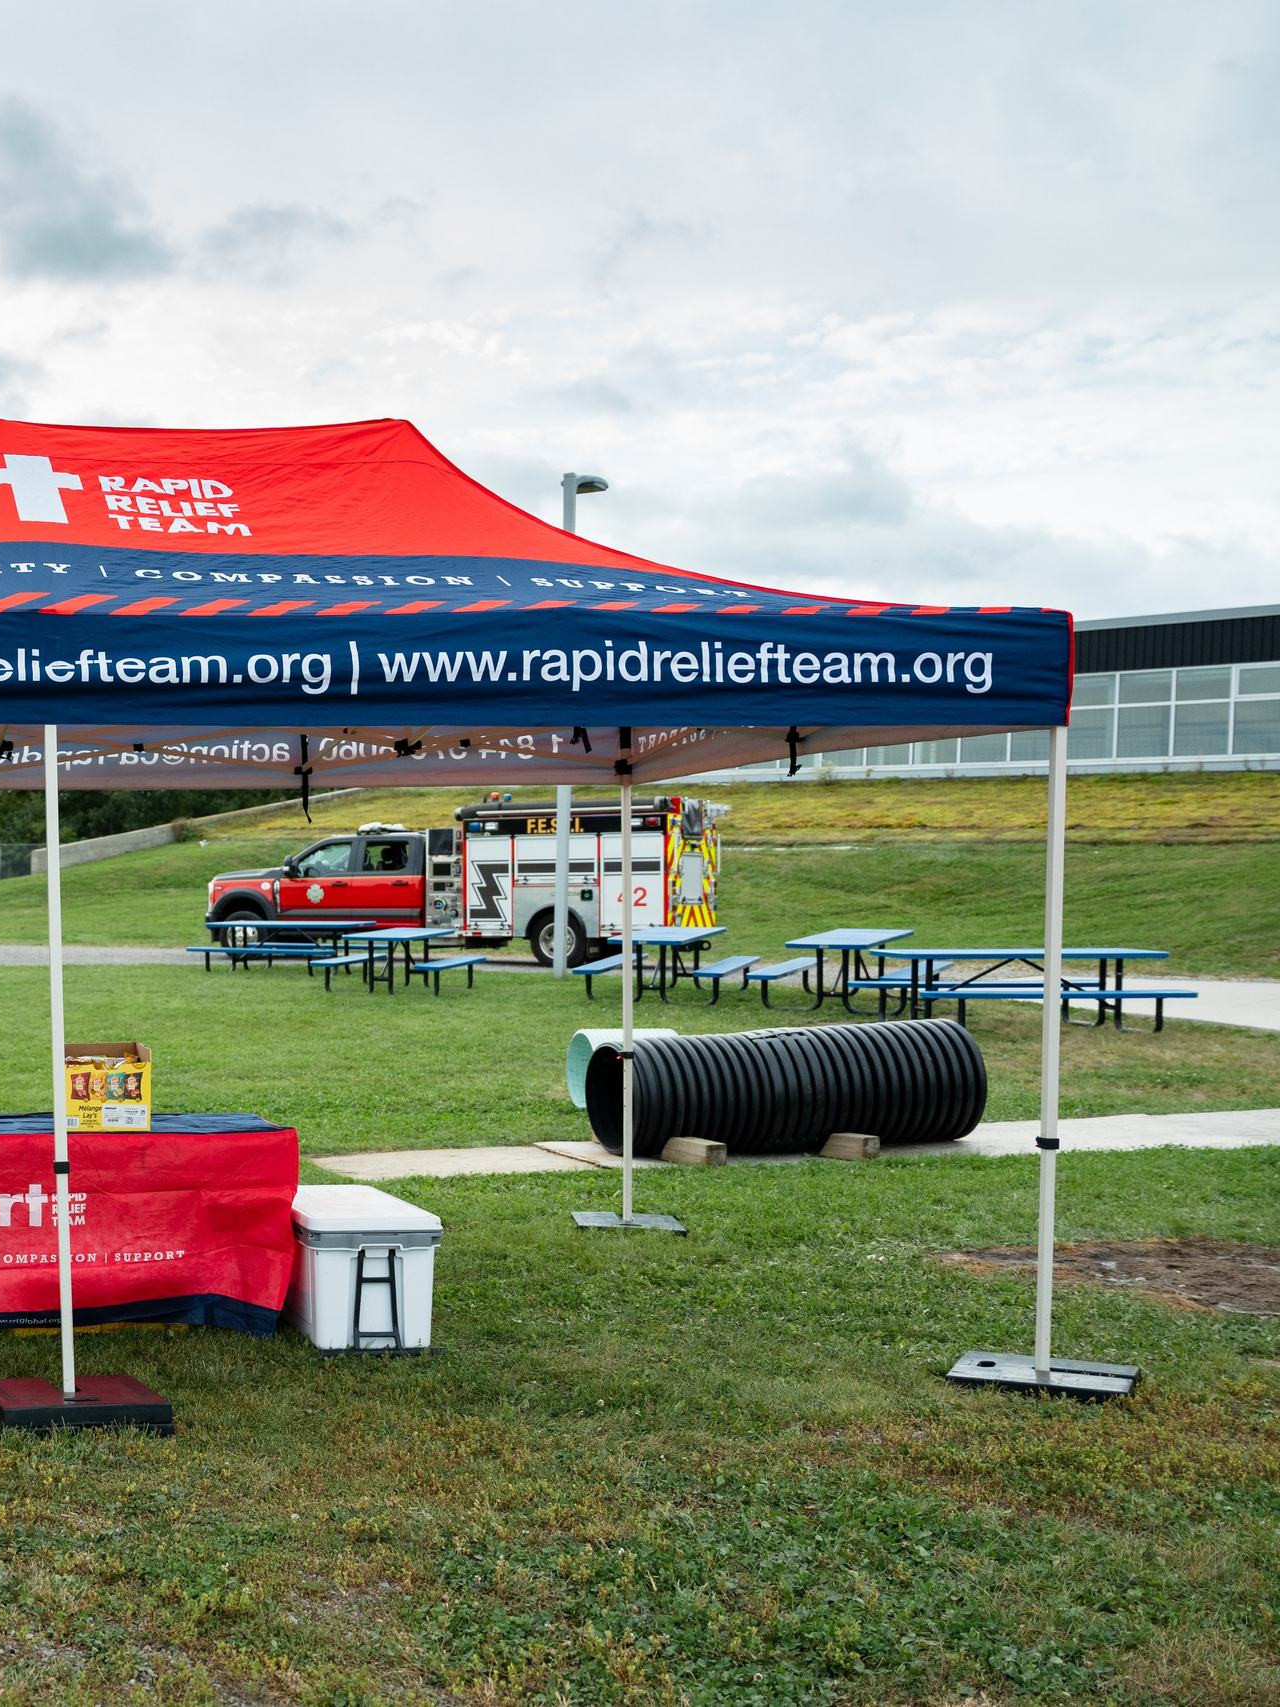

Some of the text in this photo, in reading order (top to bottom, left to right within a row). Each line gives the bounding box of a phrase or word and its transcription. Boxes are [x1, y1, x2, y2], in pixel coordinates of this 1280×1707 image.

[98, 475, 234, 499] RAPID
[105, 494, 241, 518] RELIEF
[108, 513, 253, 537] TEAM
[134, 569, 474, 586] COMPASSION
[530, 577, 753, 598] SUPPORT
[377, 639, 993, 694] www.rapidreliefteam.org
[78, 1104, 102, 1112] Mélange
[51, 1192, 87, 1202] RPID
[52, 1203, 86, 1214] RIEF
[51, 1215, 85, 1227] TAM
[114, 1249, 185, 1263] SUPPORT
